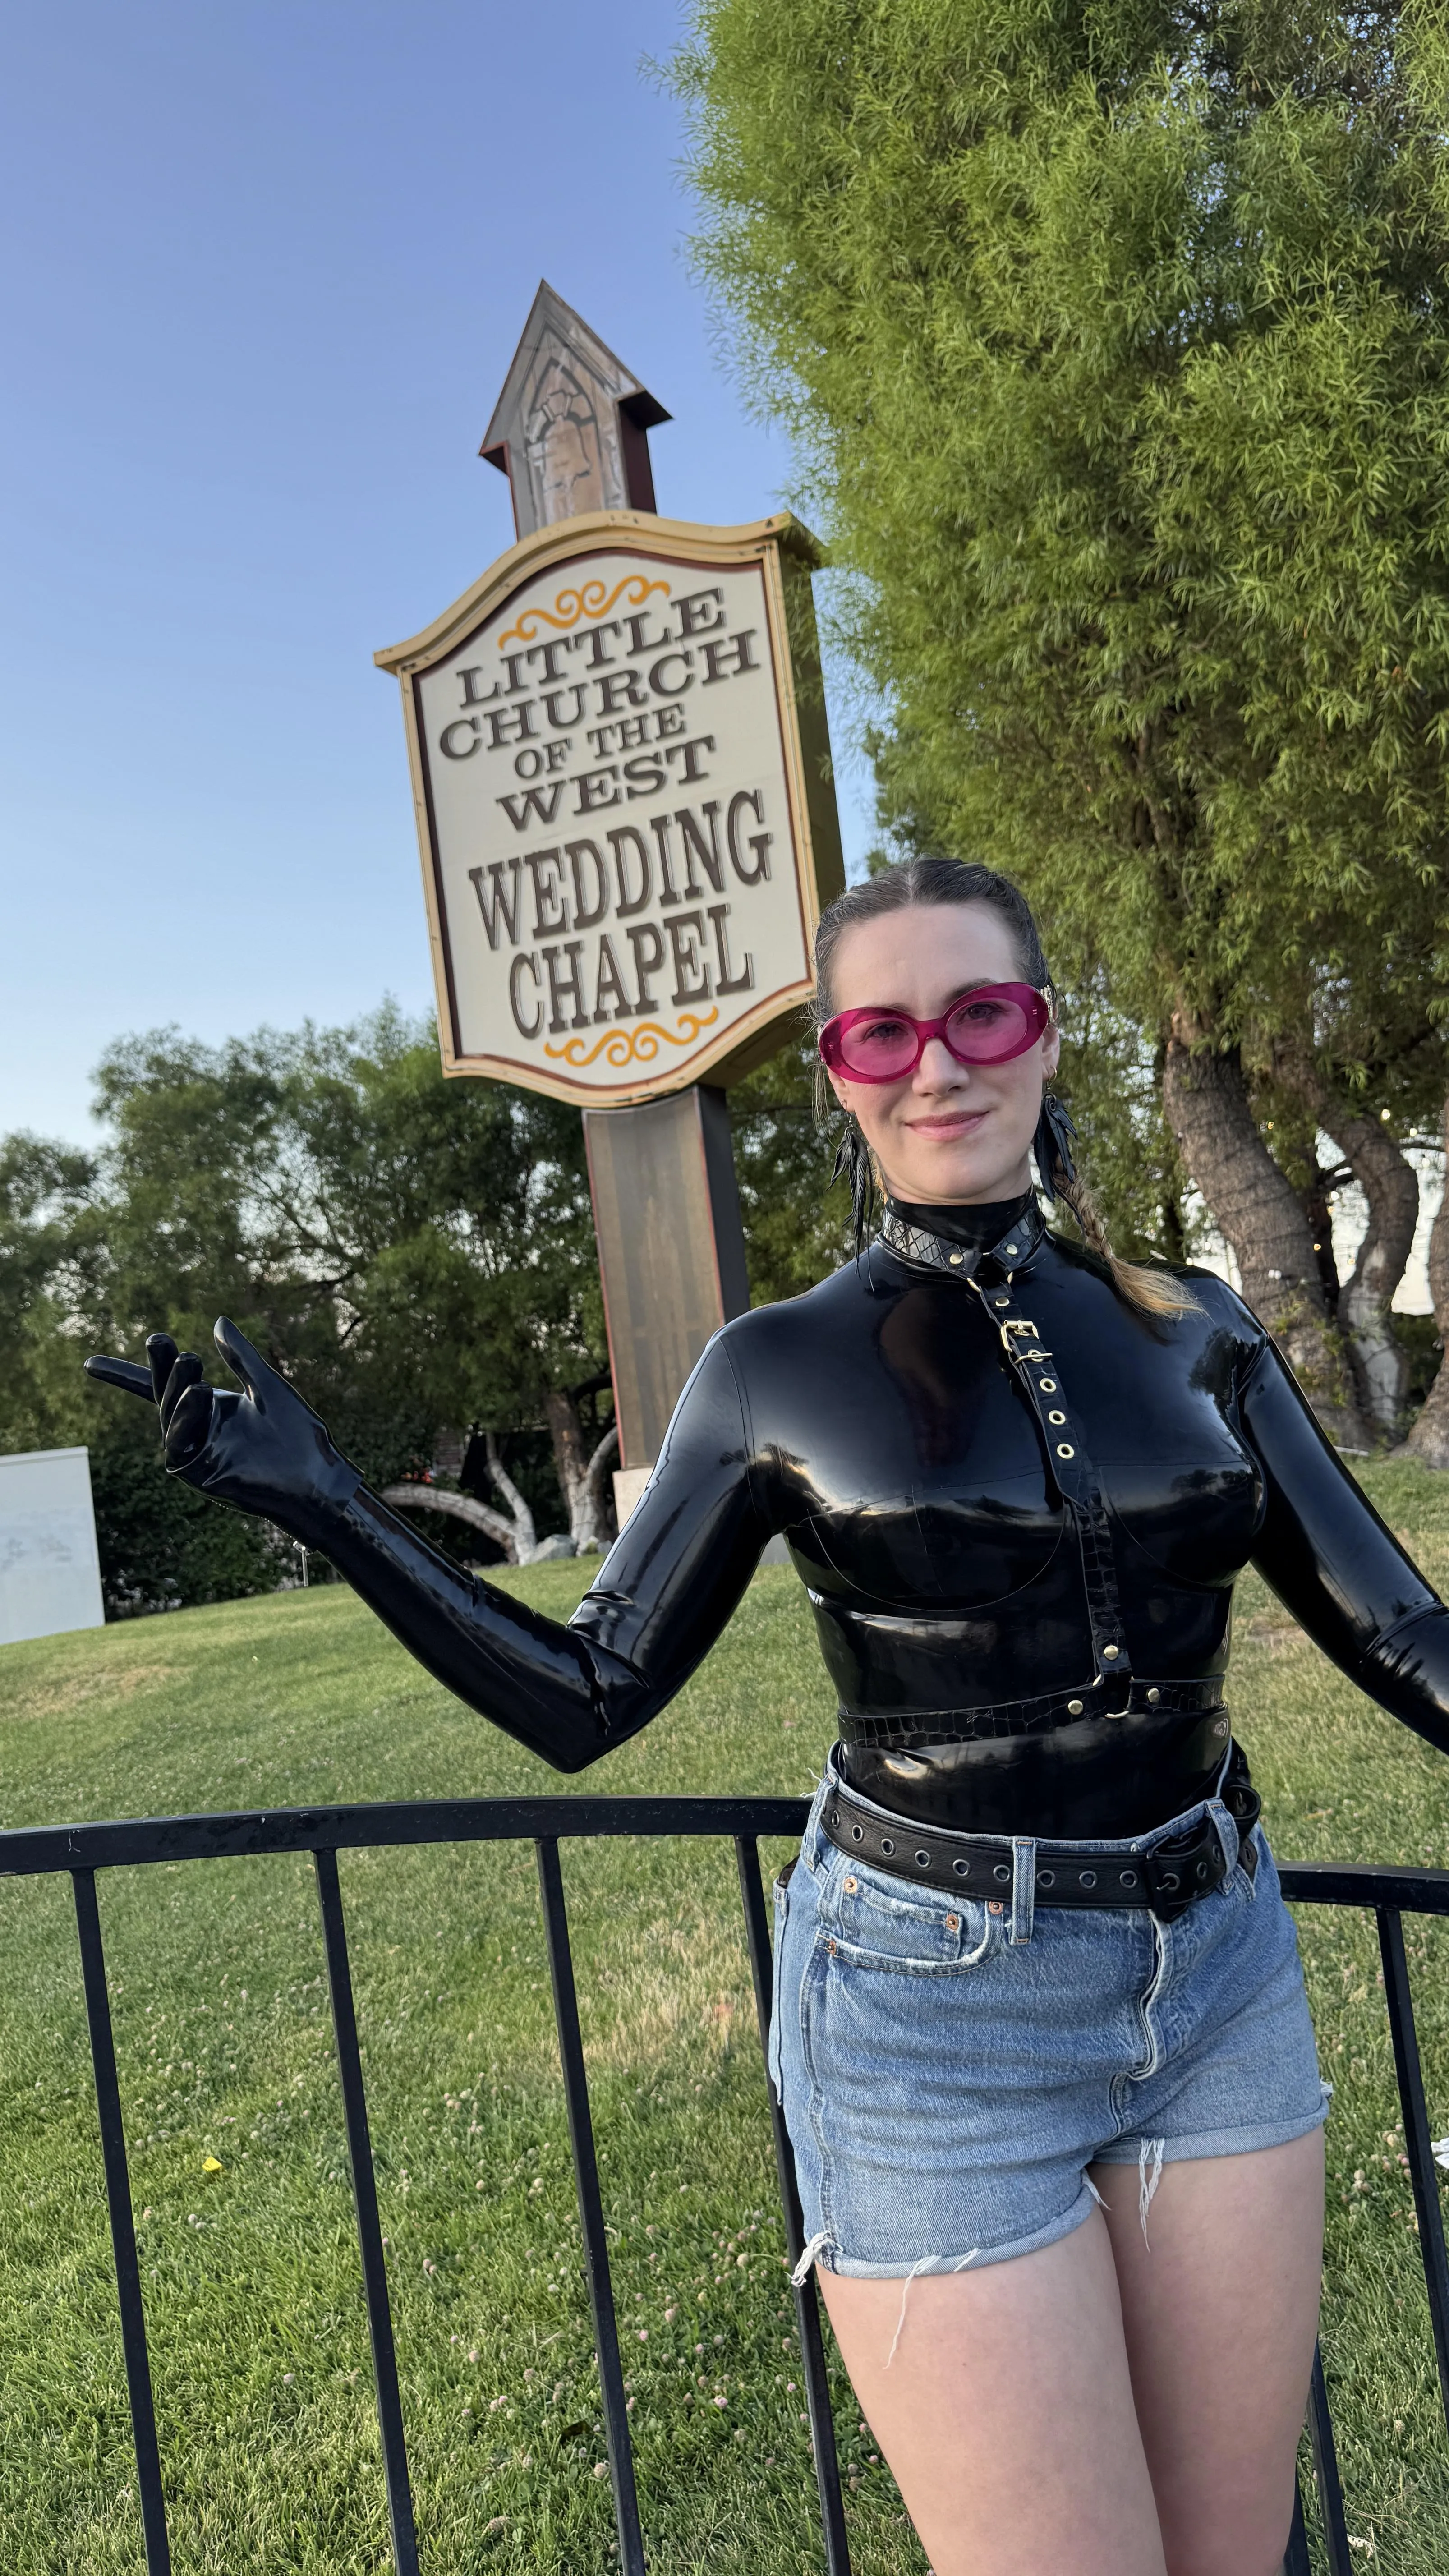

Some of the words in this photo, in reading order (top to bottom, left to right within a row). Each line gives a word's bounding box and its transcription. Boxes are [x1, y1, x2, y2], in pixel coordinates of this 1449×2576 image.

[440, 630, 759, 759] CHURCH
[457, 588, 727, 708] LITTLE
[496, 736, 715, 832] WEST
[514, 738, 571, 779] OF
[587, 704, 687, 759] THE
[469, 790, 773, 950] WEDDING
[510, 904, 755, 1039] CHAPEL
